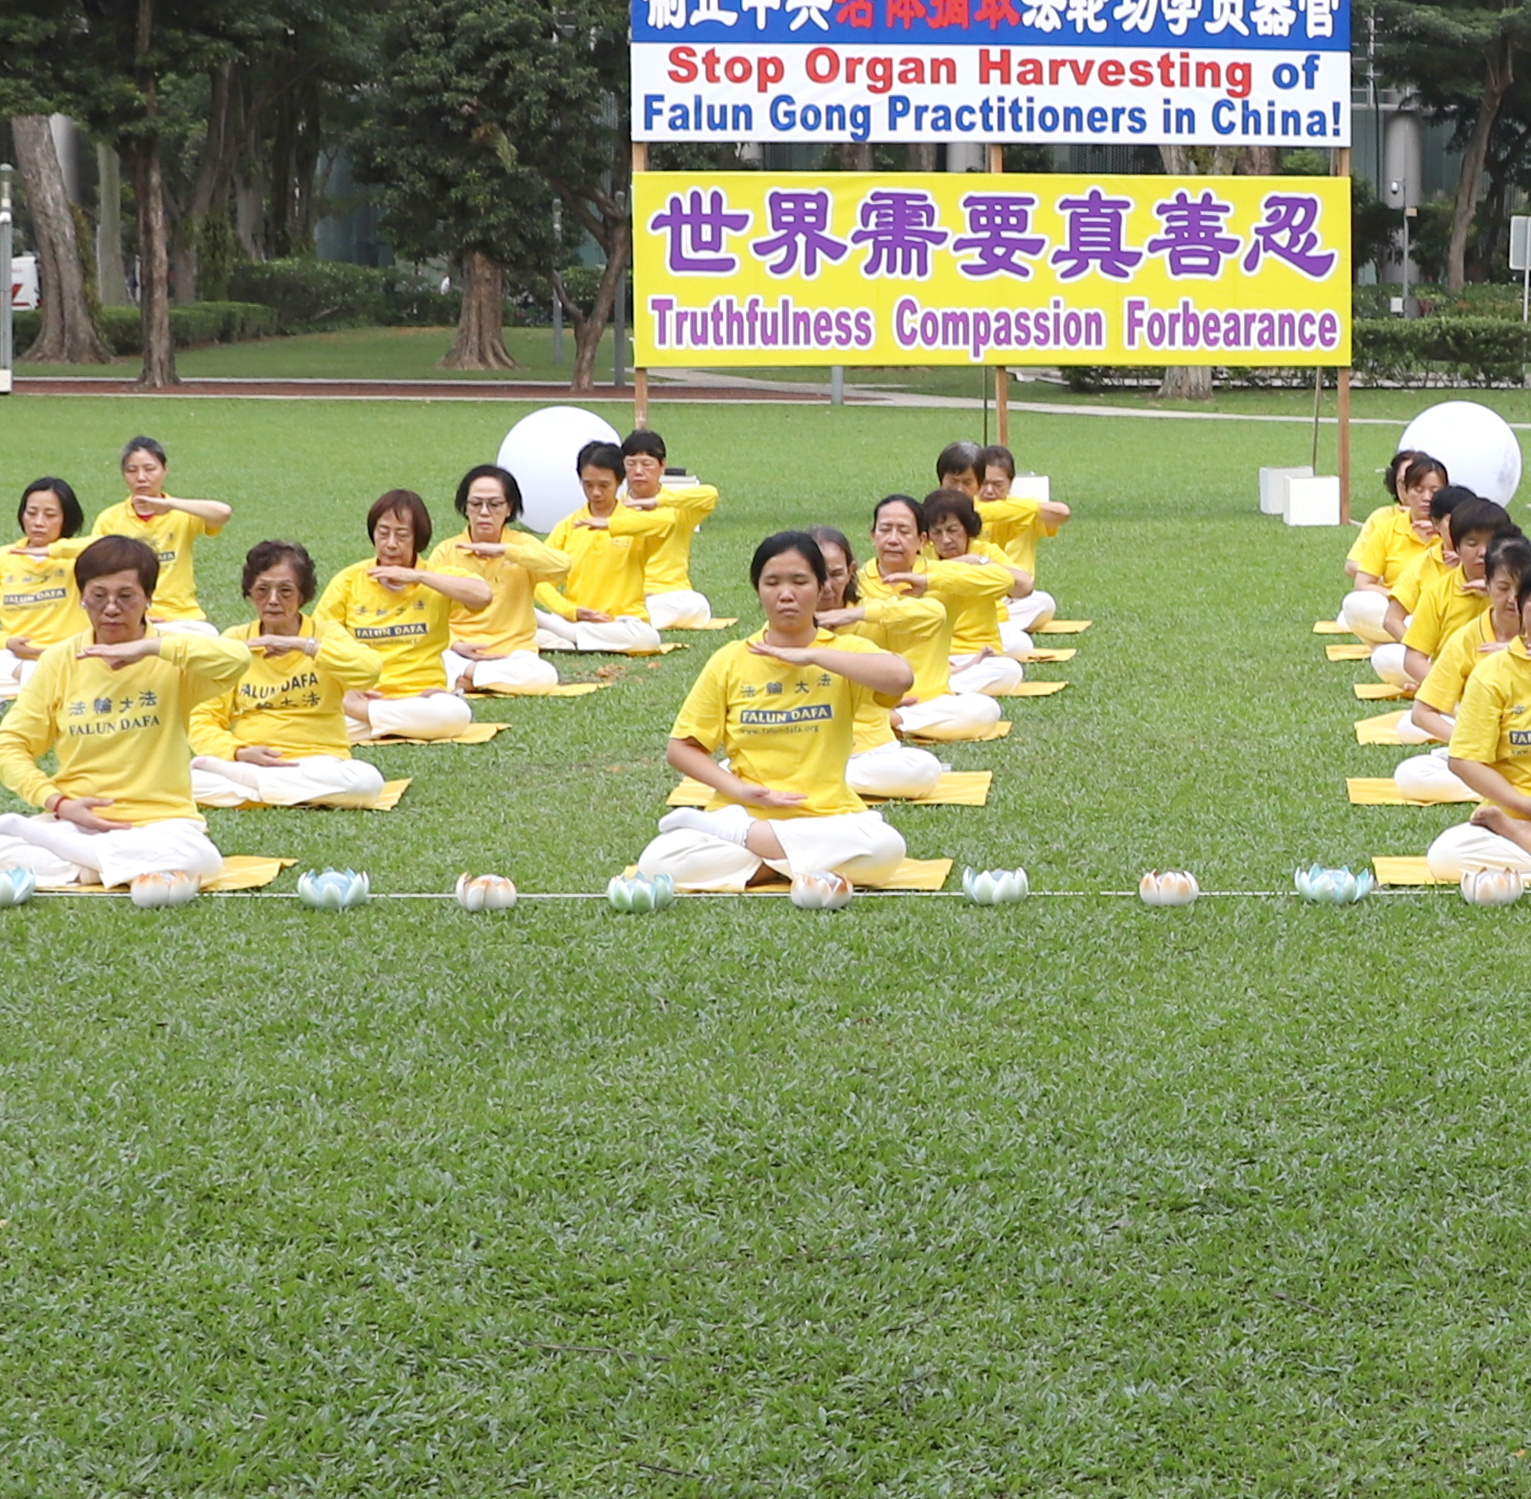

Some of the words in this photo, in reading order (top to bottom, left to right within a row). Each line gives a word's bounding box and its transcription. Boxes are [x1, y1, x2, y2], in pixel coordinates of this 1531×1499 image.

[668, 46, 785, 93] Stop
[805, 46, 957, 94] Organ
[978, 48, 1253, 98] Harvesting
[1273, 54, 1320, 90] of
[644, 93, 754, 133] Falun
[768, 93, 869, 141] Gong
[887, 95, 1147, 135] Practitioners
[1163, 96, 1196, 135] in
[1211, 98, 1341, 138] China!
[650, 189, 1336, 279] 世界需要真善忍
[651, 297, 874, 348] Truthfulness
[894, 299, 1103, 358] Compassion
[1126, 299, 1338, 349] Forbearance
[36, 589, 65, 600] DAFA
[356, 627, 391, 638] FALUN
[395, 623, 425, 635] DAFA
[281, 672, 319, 692] DAFA
[68, 689, 158, 716] 法輪大法
[742, 710, 787, 723] FALUN
[791, 706, 829, 720] DAFA
[68, 721, 117, 737] FALUN
[119, 714, 160, 732] DAFA
